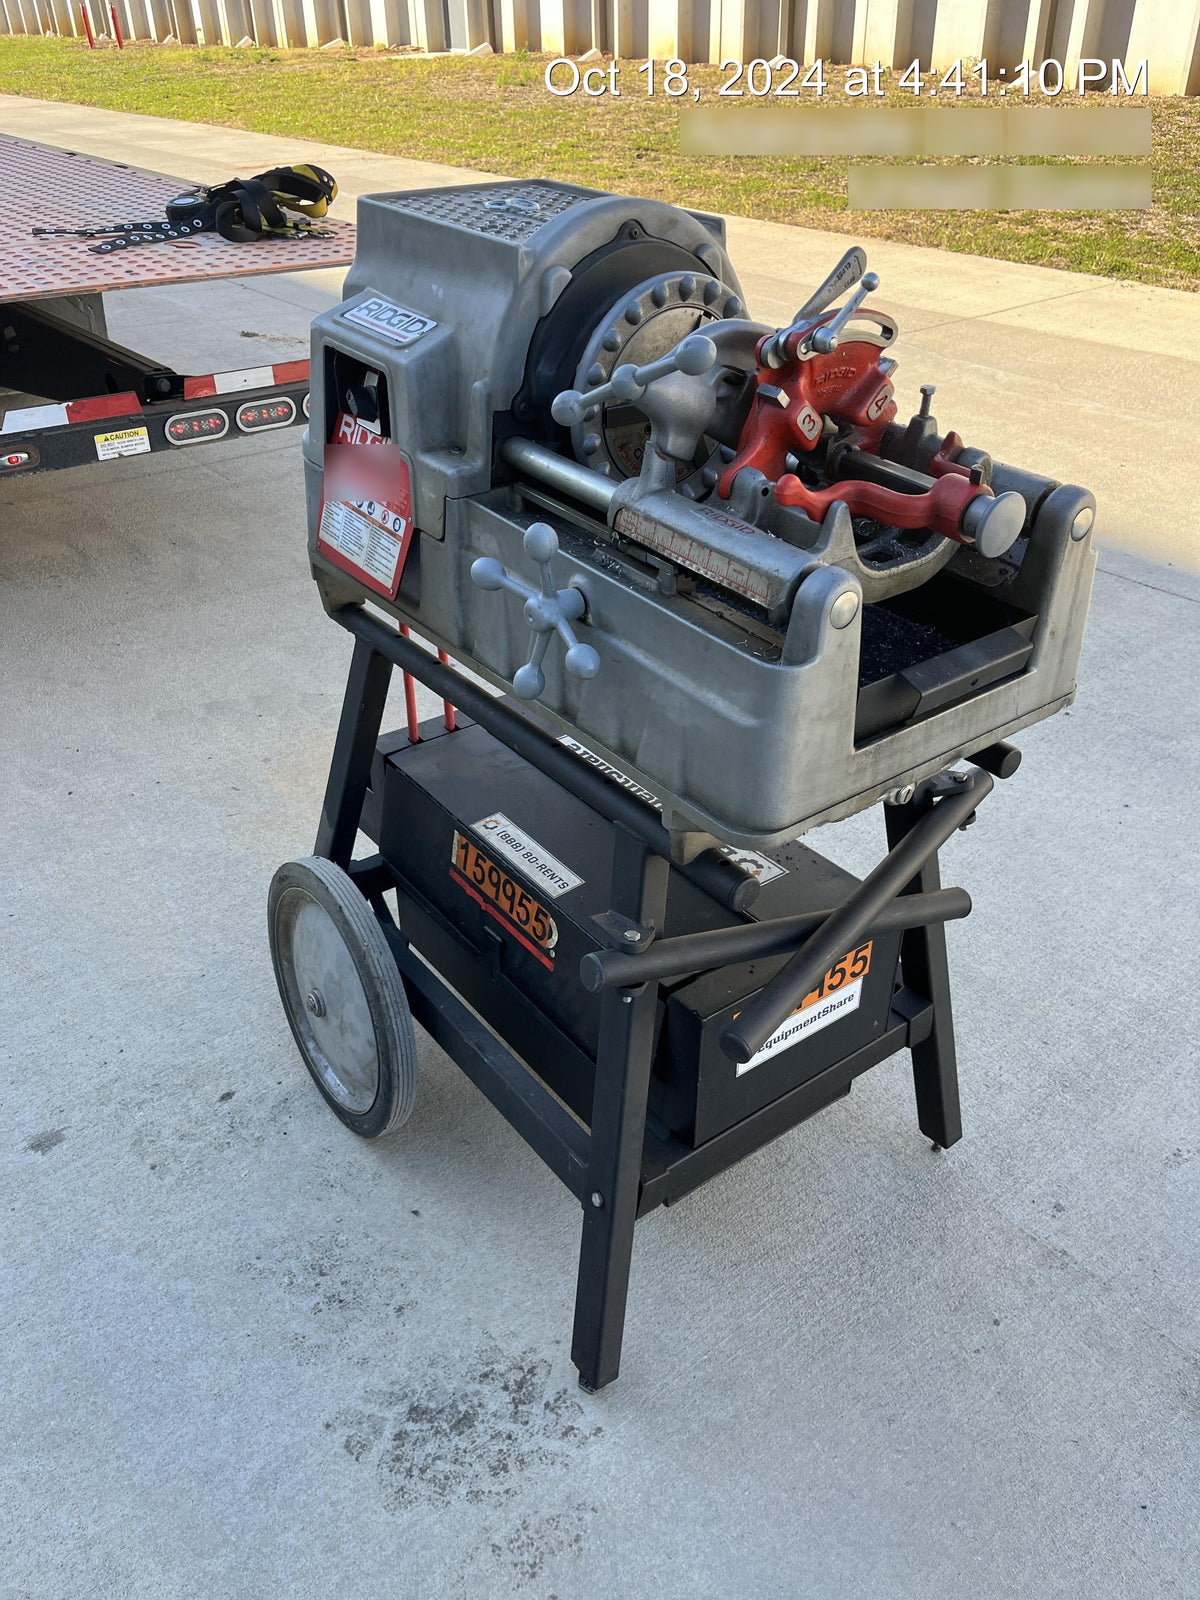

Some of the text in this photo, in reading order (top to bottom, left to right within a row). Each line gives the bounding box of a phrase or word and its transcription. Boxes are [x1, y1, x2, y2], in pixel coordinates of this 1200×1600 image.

[356, 300, 428, 334] RIDGID
[874, 394, 889, 413] 4
[109, 430, 139, 441] CAUTION
[802, 413, 817, 432] 3
[496, 830, 570, 891] (888) 80-RENTS
[460, 842, 549, 942] 159955
